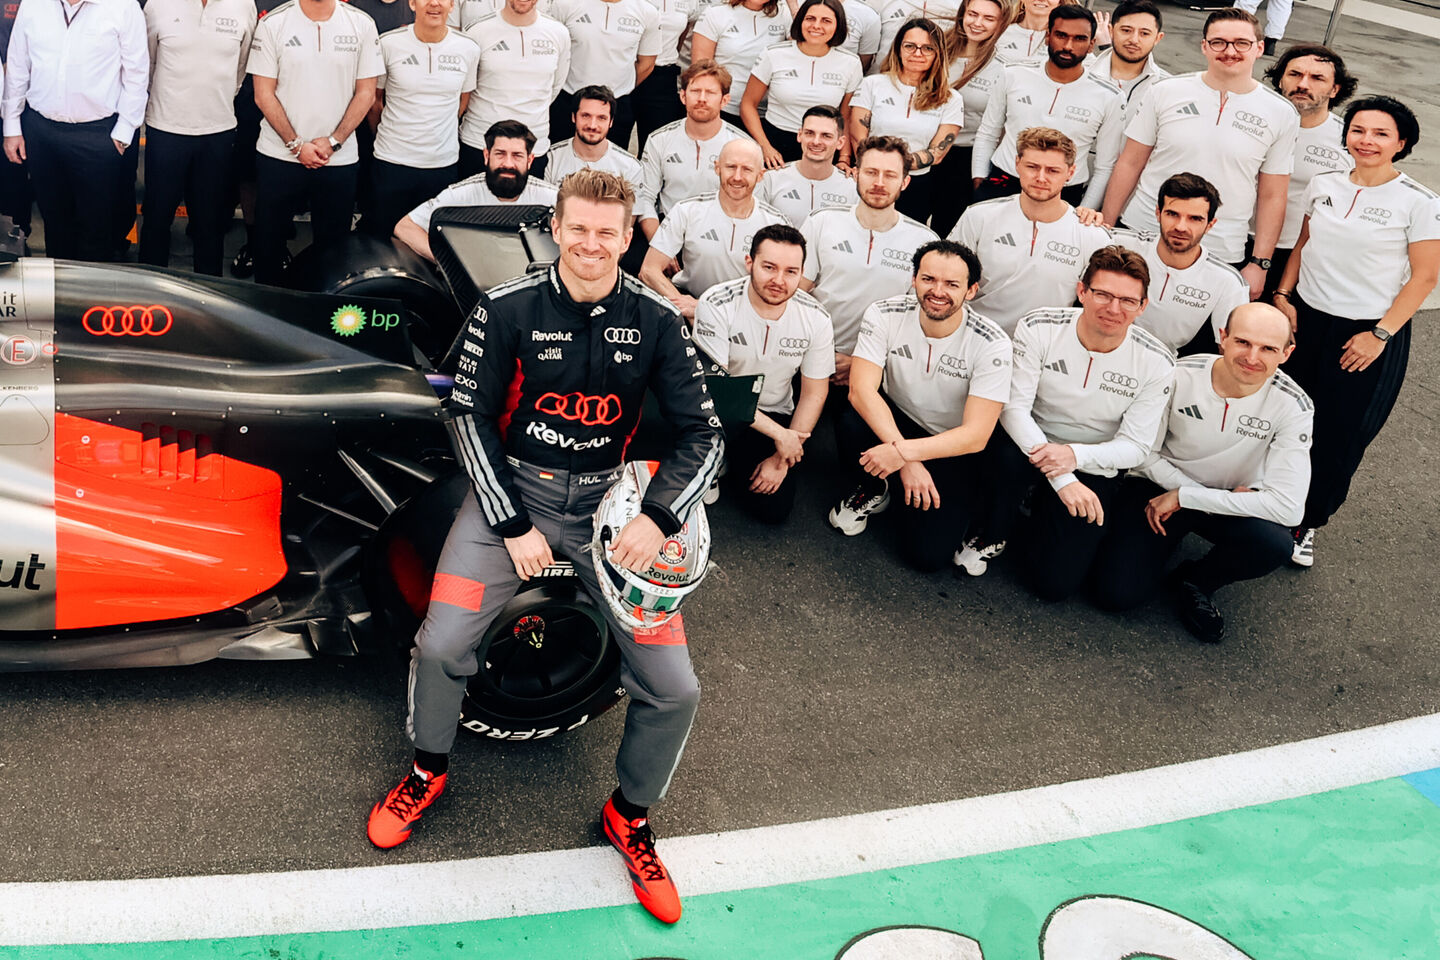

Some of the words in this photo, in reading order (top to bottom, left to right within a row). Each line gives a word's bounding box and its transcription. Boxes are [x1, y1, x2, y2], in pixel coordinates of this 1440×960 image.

[1232, 120, 1265, 138] Revolut
[1303, 155, 1337, 170] Revolut
[881, 259, 911, 273] Revolut
[1044, 251, 1077, 266] Revolut
[1172, 294, 1207, 309] Revolut
[371, 309, 400, 331] bp
[532, 330, 572, 342] Revolut
[537, 352, 563, 361] QATAR
[622, 352, 633, 362] bp
[458, 360, 477, 374] YATT
[938, 365, 969, 380] Revolut
[1099, 383, 1136, 399] Revolut
[644, 567, 690, 583] Revolut
[567, 714, 590, 732] P
